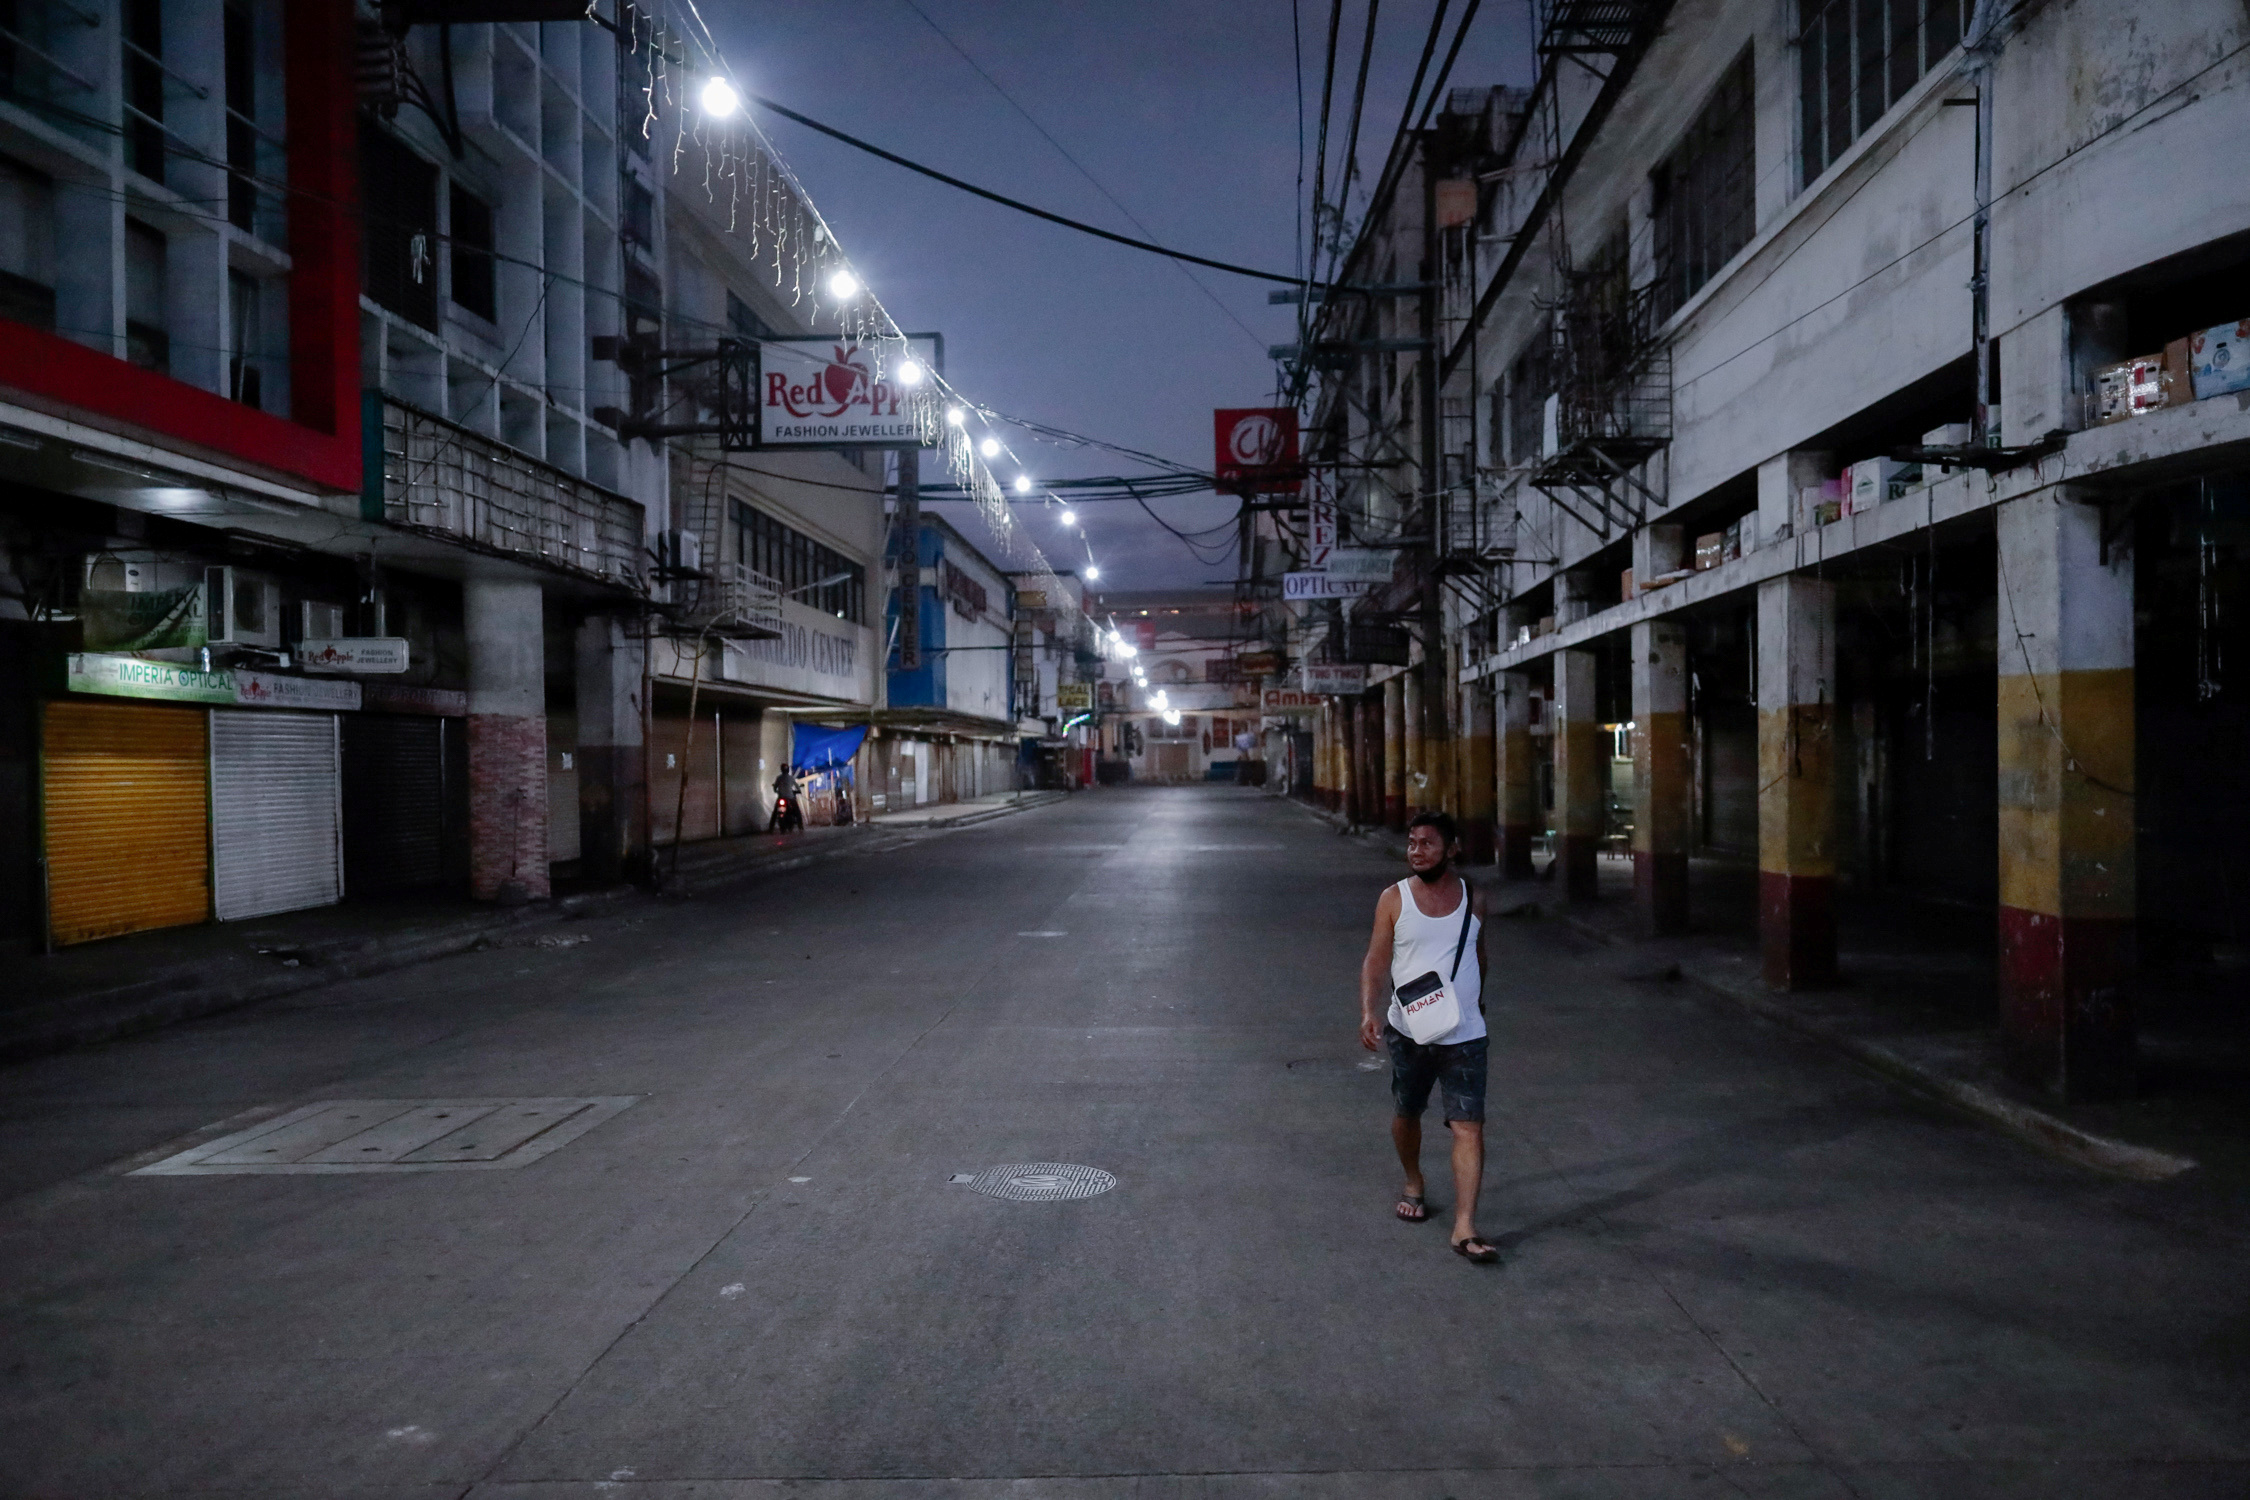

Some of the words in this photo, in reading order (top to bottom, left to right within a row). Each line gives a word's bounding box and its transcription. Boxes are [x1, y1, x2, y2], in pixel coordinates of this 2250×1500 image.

[765, 371, 825, 417] Red
[820, 372, 905, 417] App
[775, 425, 838, 437] FASHION
[901, 573, 916, 666] CENTER
[308, 651, 324, 665] Red
[812, 628, 854, 678] CENTER
[119, 663, 174, 686] IMPERIA
[178, 670, 233, 691] OPTICAL
